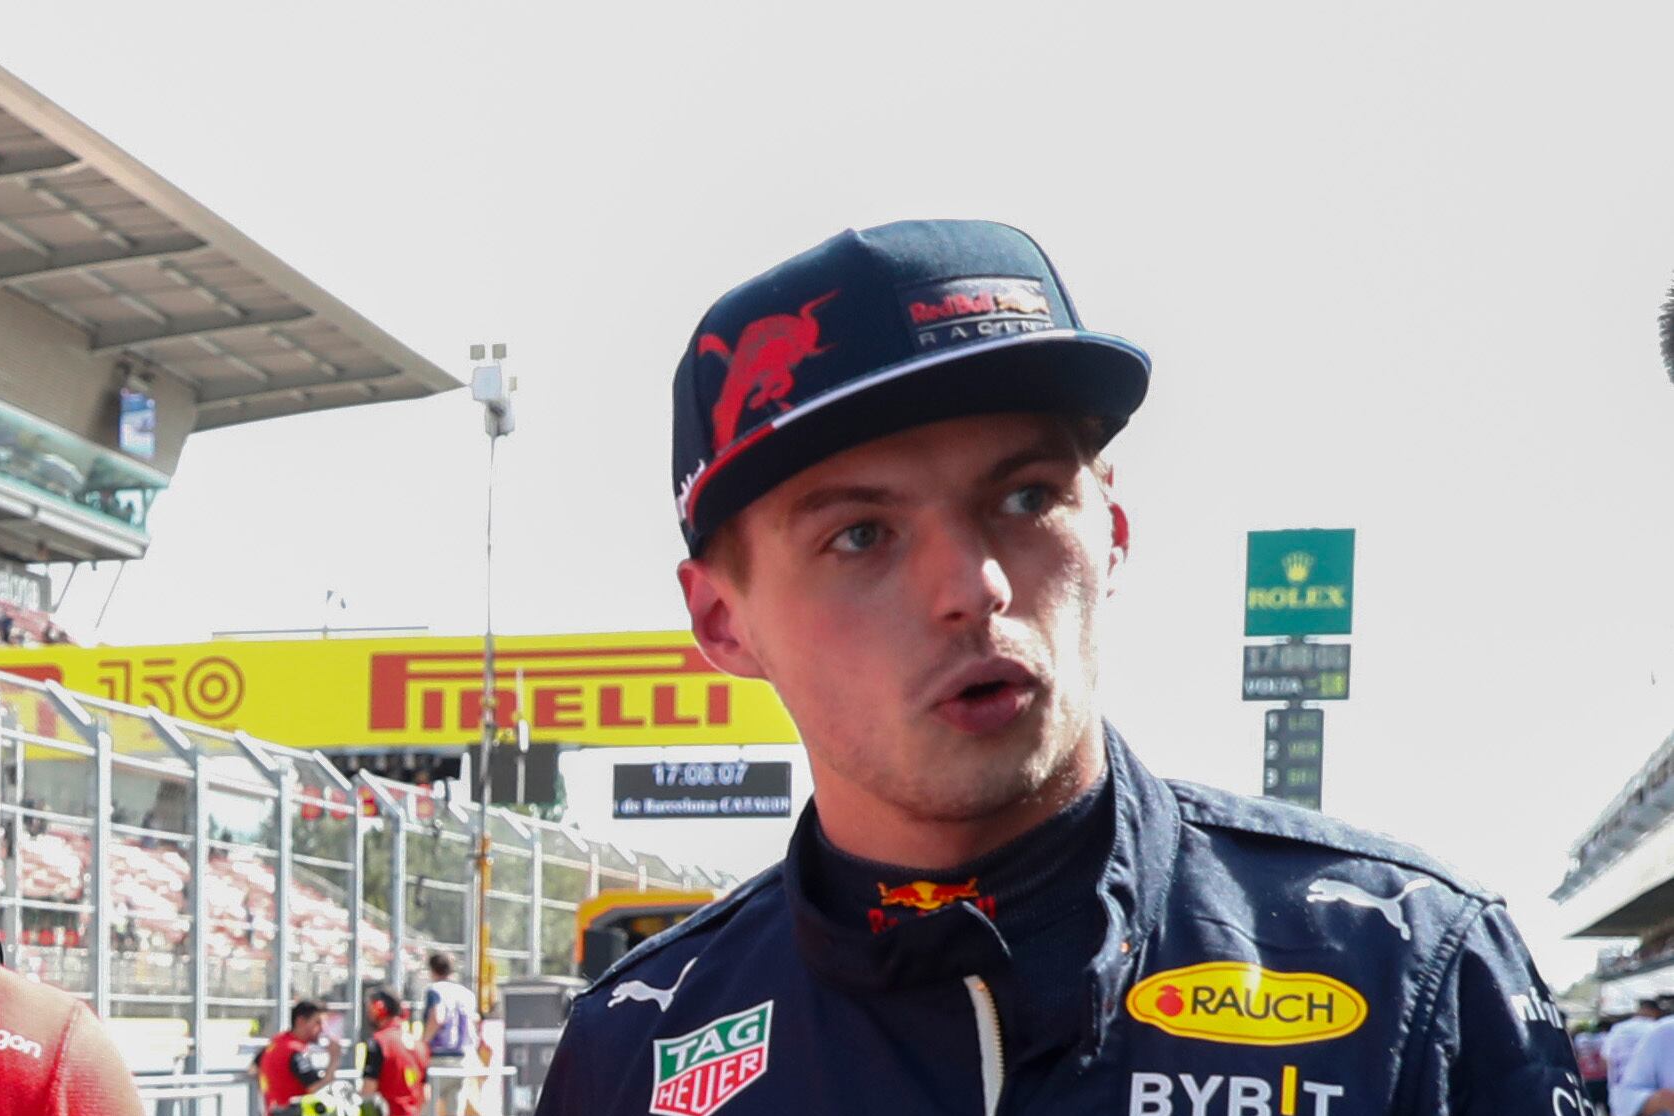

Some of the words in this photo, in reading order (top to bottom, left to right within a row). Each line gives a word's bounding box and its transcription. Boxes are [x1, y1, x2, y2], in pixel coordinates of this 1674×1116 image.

[1246, 585, 1346, 609] ROLEX
[370, 647, 731, 732] PIRELLI
[1191, 985, 1335, 1024] RAUCH
[667, 1013, 760, 1073] TAG
[658, 1051, 760, 1114] HEUER
